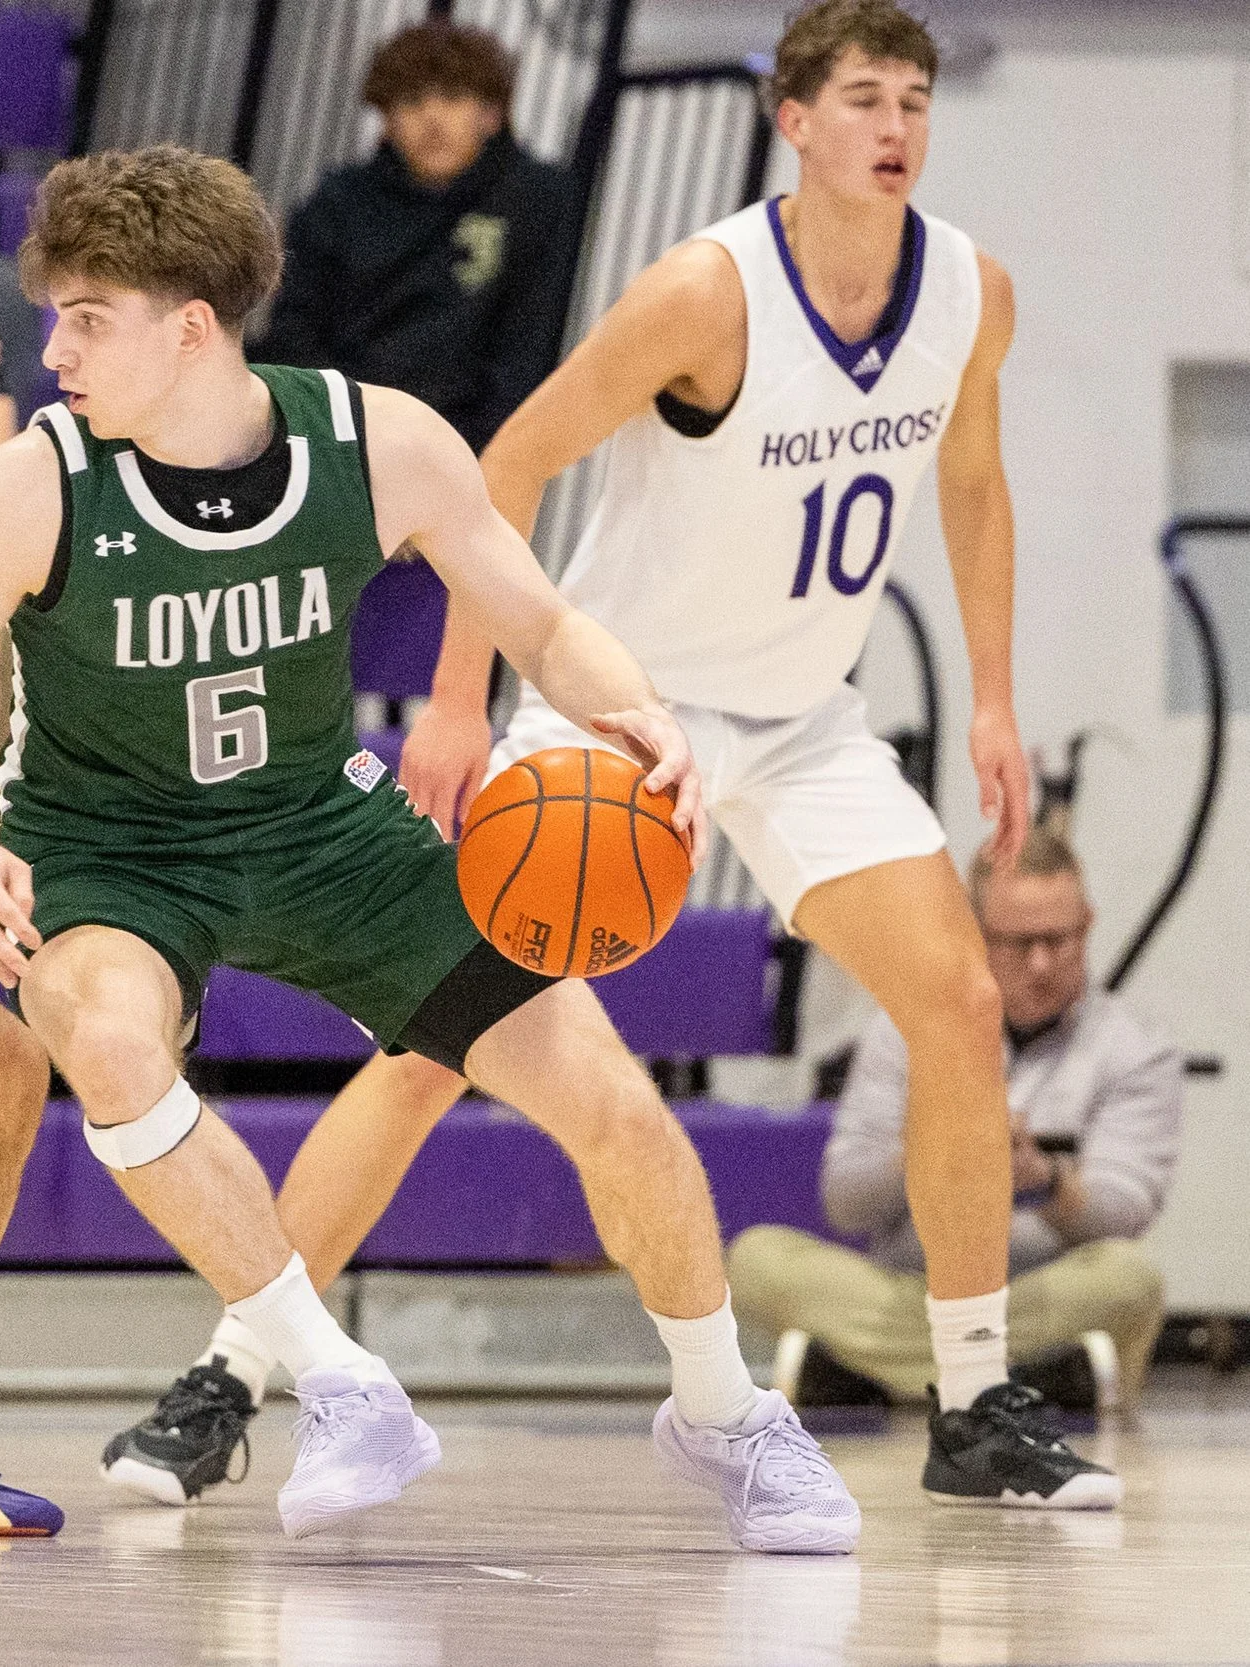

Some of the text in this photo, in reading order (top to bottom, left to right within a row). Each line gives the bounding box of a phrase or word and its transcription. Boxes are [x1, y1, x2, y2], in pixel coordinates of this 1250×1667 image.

[760, 427, 844, 468] HOLY
[789, 473, 894, 599] 10
[113, 566, 332, 668] LOYOLA
[185, 665, 268, 784] 6
[356, 757, 379, 785] PATRIOT
[523, 918, 552, 970] PRO
